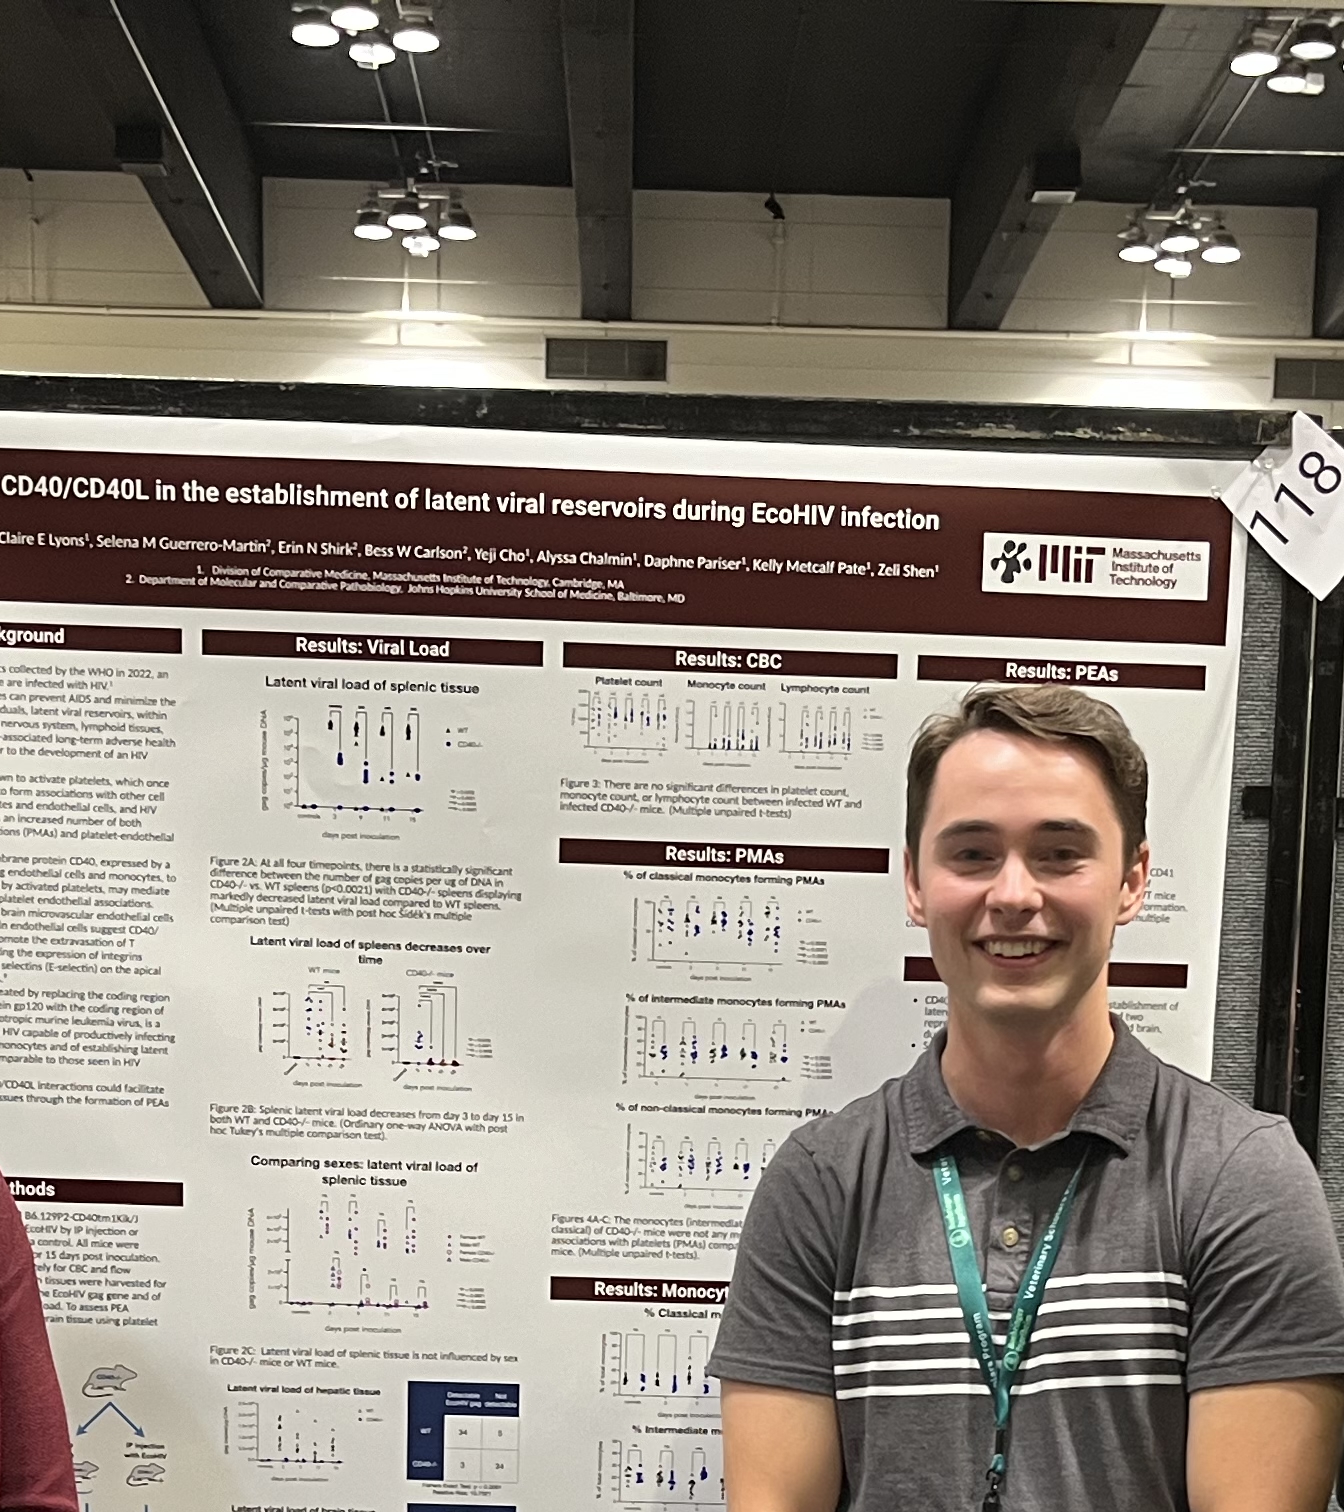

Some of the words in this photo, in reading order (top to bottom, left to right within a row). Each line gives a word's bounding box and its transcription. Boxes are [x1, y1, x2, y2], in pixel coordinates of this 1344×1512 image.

[1, 474, 150, 500] CD40/CD40L
[155, 478, 176, 502] in
[181, 479, 220, 503] the
[225, 482, 389, 509] establishment
[394, 487, 420, 510] of
[425, 487, 491, 513] latent
[496, 491, 545, 515] viral
[551, 496, 667, 520] reservoirs
[672, 498, 745, 528] during
[752, 502, 836, 526] EcoHIV
[840, 505, 940, 531] infection
[1249, 451, 1342, 545] 118
[1039, 544, 1106, 583] MIT
[1112, 547, 1202, 562] Massachusetts
[1111, 560, 1160, 574] Institute
[1161, 562, 1174, 574] of
[1109, 573, 1178, 590] Technology
[296, 636, 363, 654] Results:
[366, 638, 405, 656] Viral
[409, 640, 450, 657] Load
[675, 650, 742, 668] Results:
[746, 652, 783, 670] CBC
[1005, 662, 1072, 680] Results:
[1075, 664, 1119, 682] PEAs
[265, 675, 307, 688] Latent
[310, 677, 338, 690] viral
[341, 678, 370, 691] load
[373, 679, 387, 691] of
[390, 680, 437, 694] splenic
[440, 682, 480, 695] tissue
[665, 845, 731, 863] Results:
[735, 847, 785, 865] PMAs
